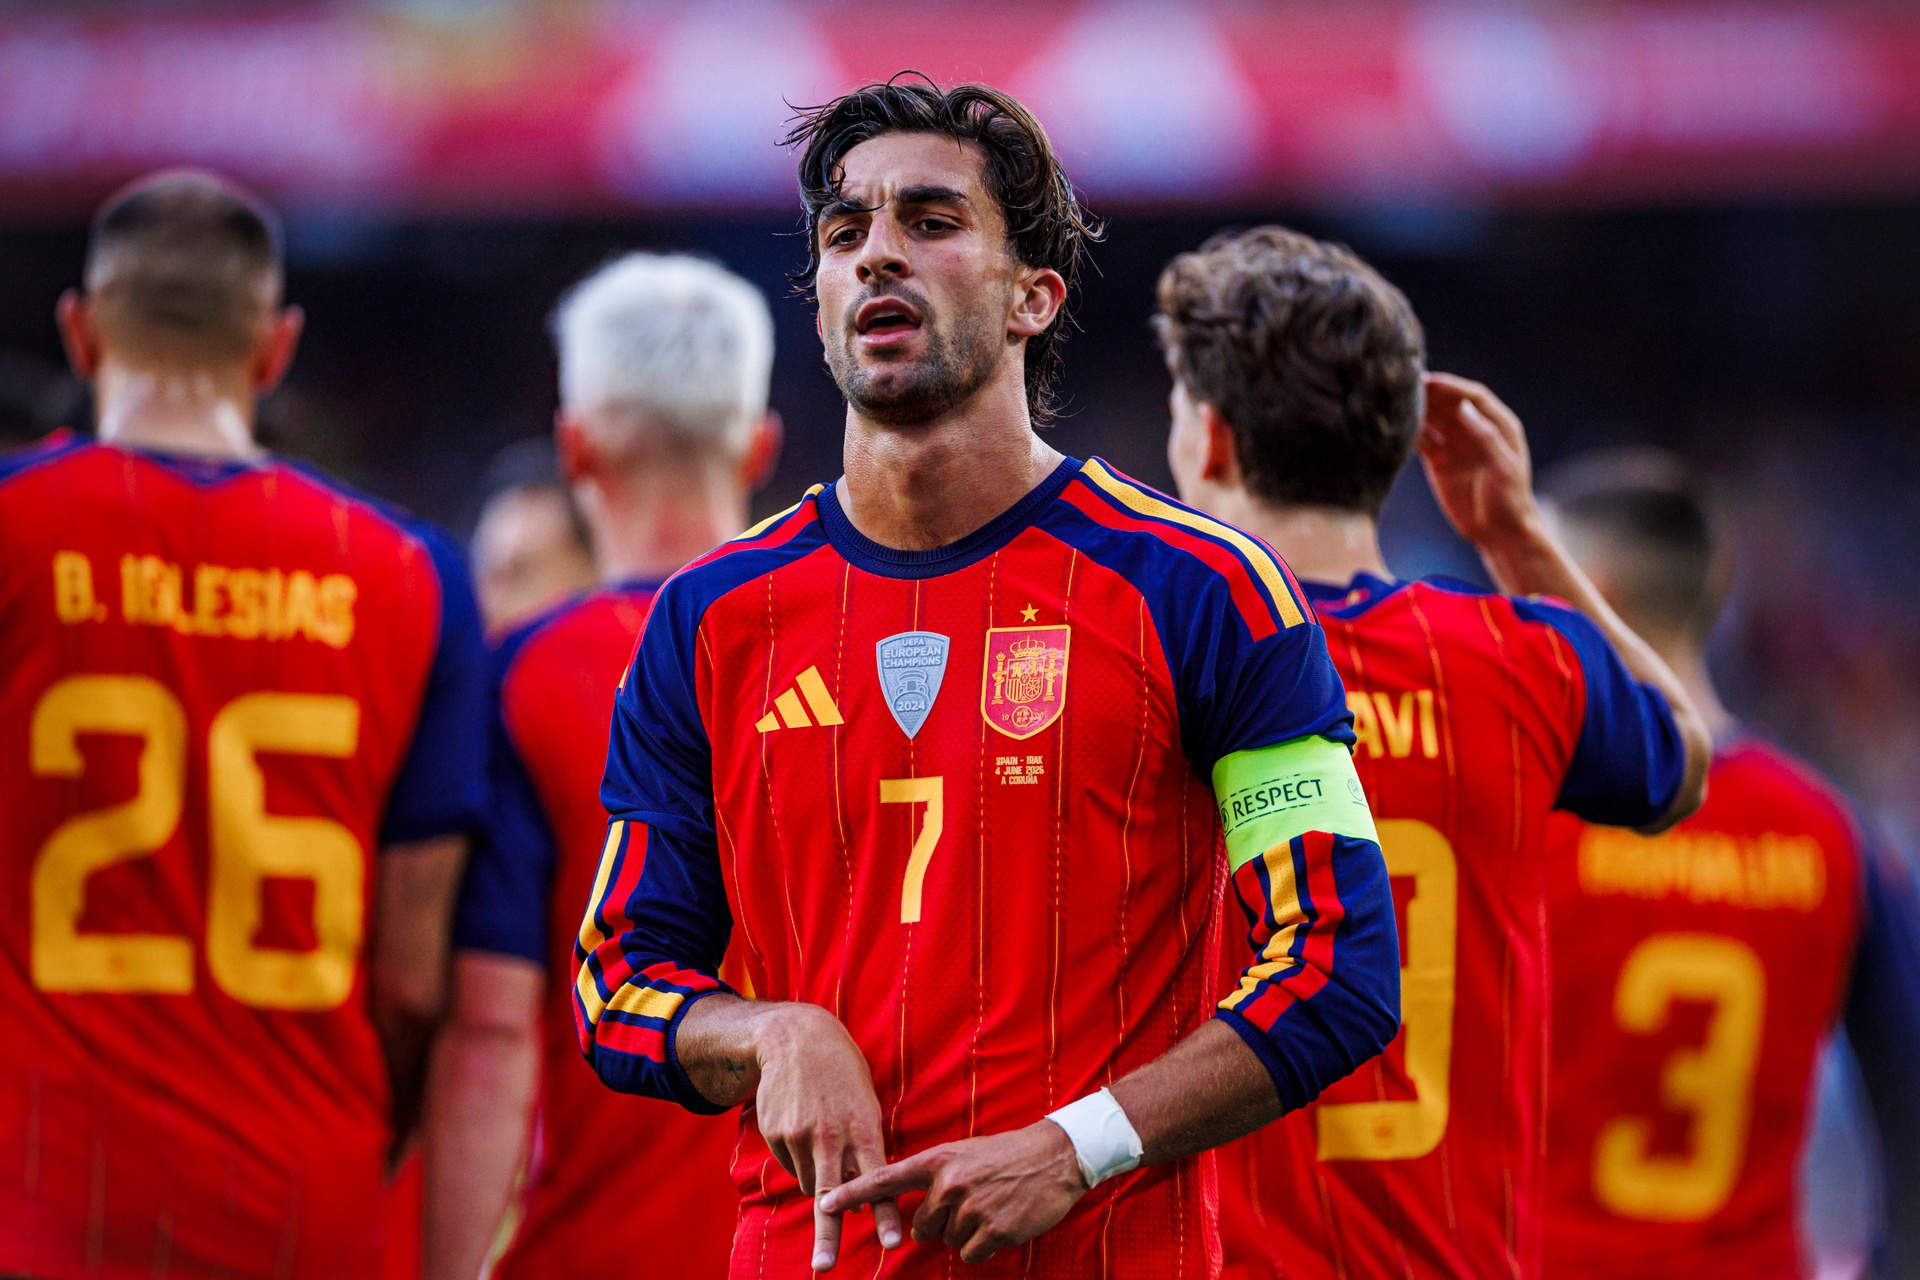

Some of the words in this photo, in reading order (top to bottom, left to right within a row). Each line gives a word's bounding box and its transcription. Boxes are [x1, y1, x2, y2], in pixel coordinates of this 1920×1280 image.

[53, 549, 108, 625] B.
[119, 552, 358, 650] IGLESIAS
[902, 637, 926, 647] UEFA
[884, 646, 942, 659] EUROPEAN
[883, 656, 942, 669] CHAMPIONS
[897, 701, 926, 711] 2024
[1345, 688, 1440, 760] AVI
[995, 756, 1018, 766] SPAIN
[1026, 755, 1043, 765] IRAK
[994, 766, 1001, 776] 4
[1003, 766, 1023, 775] JUNE
[1000, 776, 1007, 785] A
[1008, 774, 1039, 785] CORUÑA
[1232, 778, 1323, 821] RESPECT
[30, 673, 365, 1013] 26
[879, 775, 944, 924] 7
[1592, 929, 1768, 1223] 3
